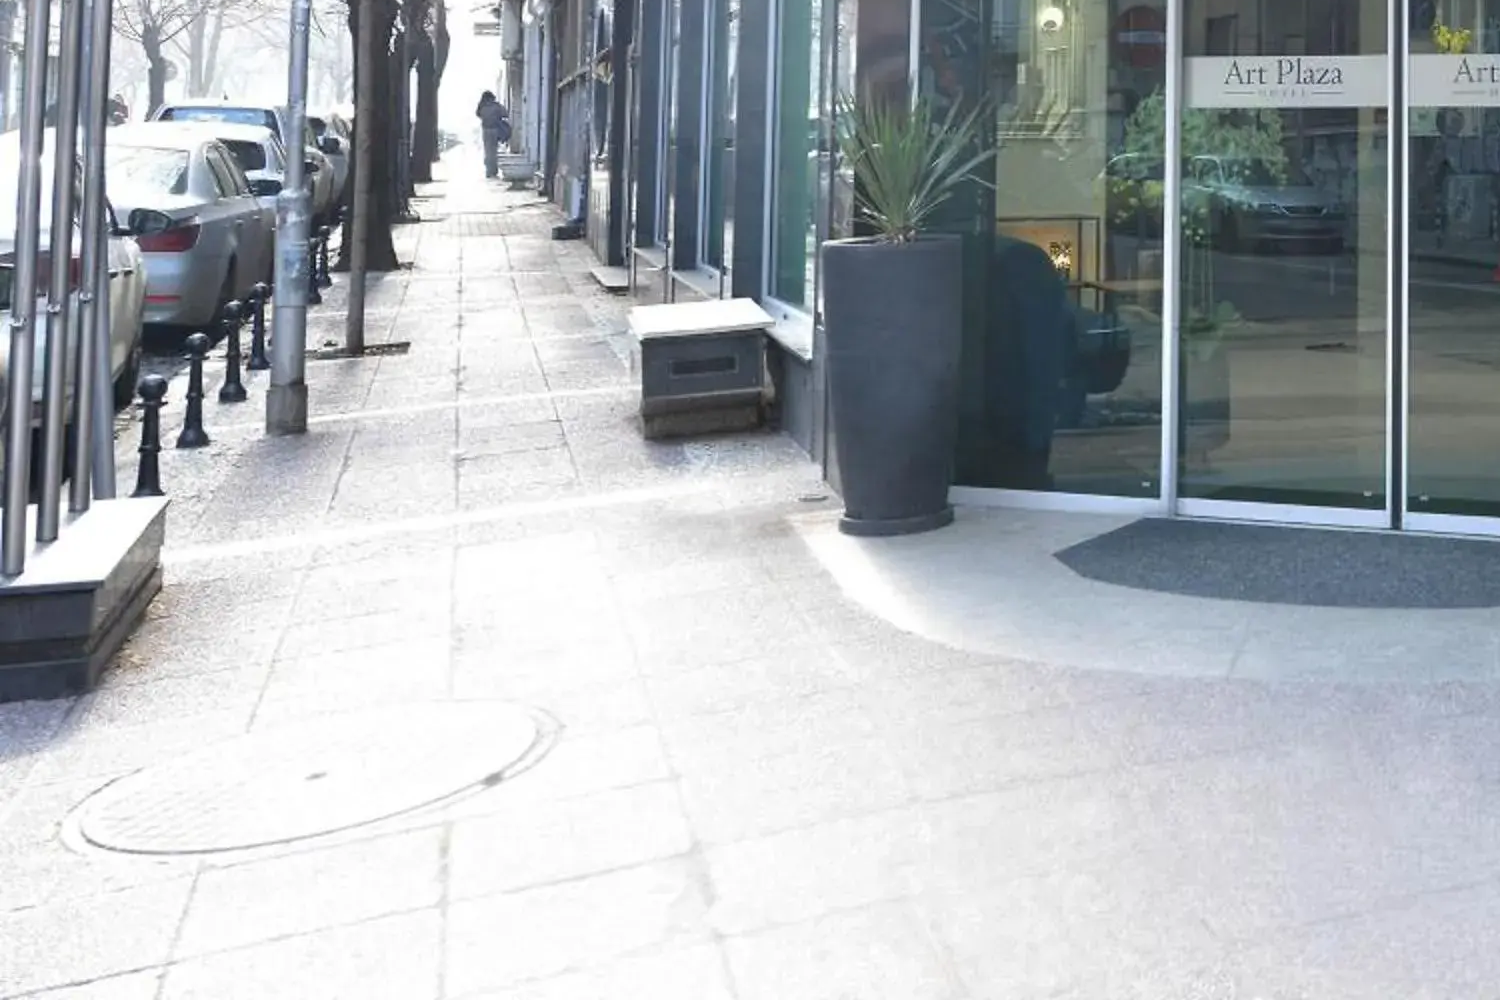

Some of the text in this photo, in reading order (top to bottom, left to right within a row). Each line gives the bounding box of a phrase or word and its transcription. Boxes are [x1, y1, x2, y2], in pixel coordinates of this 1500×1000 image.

[1224, 57, 1343, 86] Art Plaza
[1453, 59, 1500, 83] Art
